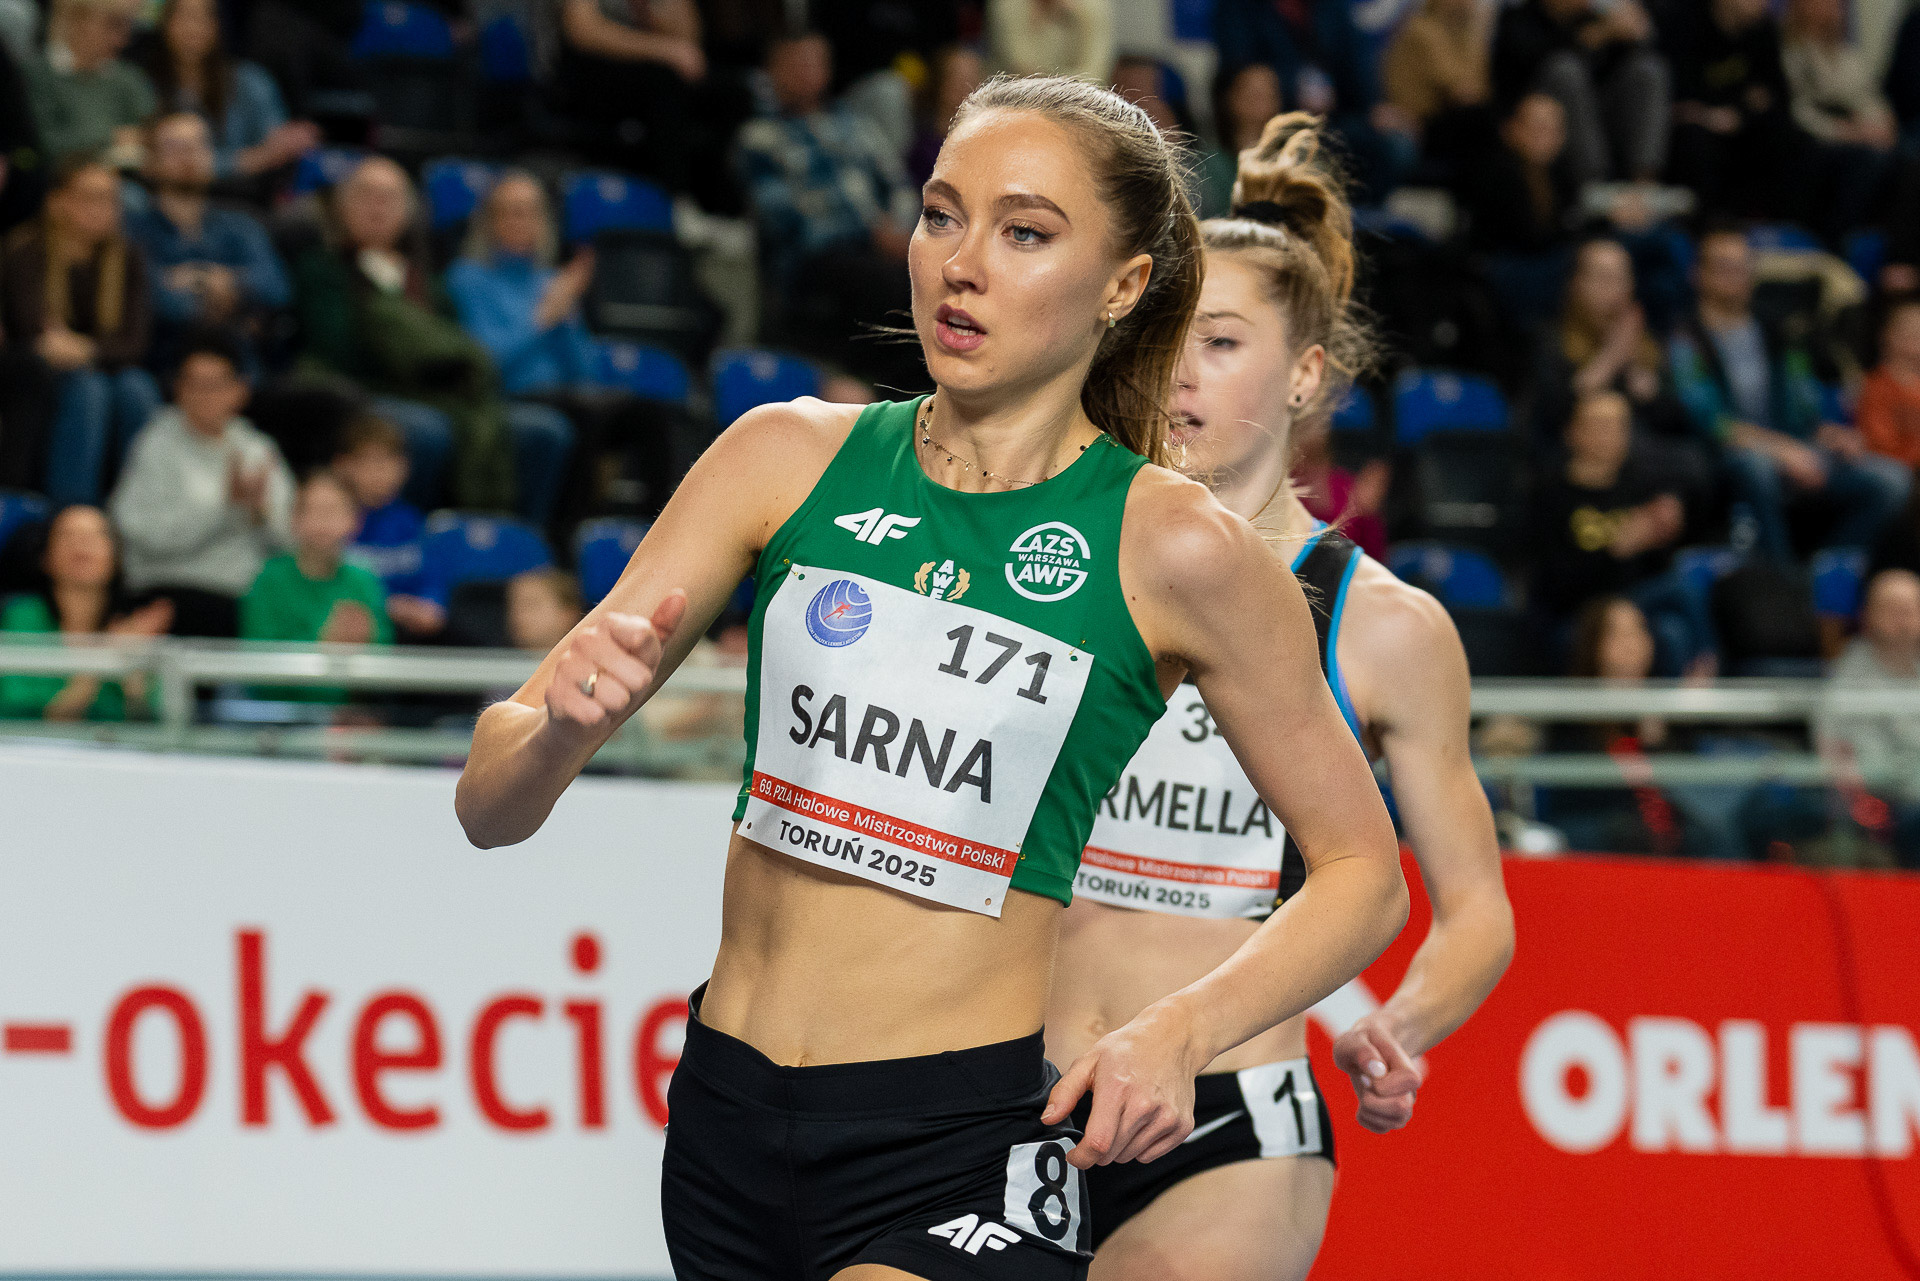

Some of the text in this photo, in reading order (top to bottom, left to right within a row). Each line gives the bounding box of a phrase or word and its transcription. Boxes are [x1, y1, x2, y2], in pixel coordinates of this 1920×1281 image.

[833, 507, 922, 546] 4F
[1027, 534, 1076, 557] AZS
[1015, 563, 1076, 587] AWF
[1018, 553, 1080, 569] WARSZAWA
[937, 624, 1053, 705] 171
[789, 684, 993, 804] SARNA
[1181, 702, 1224, 743] 3
[759, 778, 1006, 870] 69. PZLA Halowe Mistrzostwa Polski
[780, 819, 938, 887] TORUŃ 2025
[1078, 870, 1212, 909] TORUŃ 2025
[1274, 1069, 1306, 1146] 1
[1027, 1141, 1072, 1241] 8
[927, 1213, 1023, 1256] 4F
